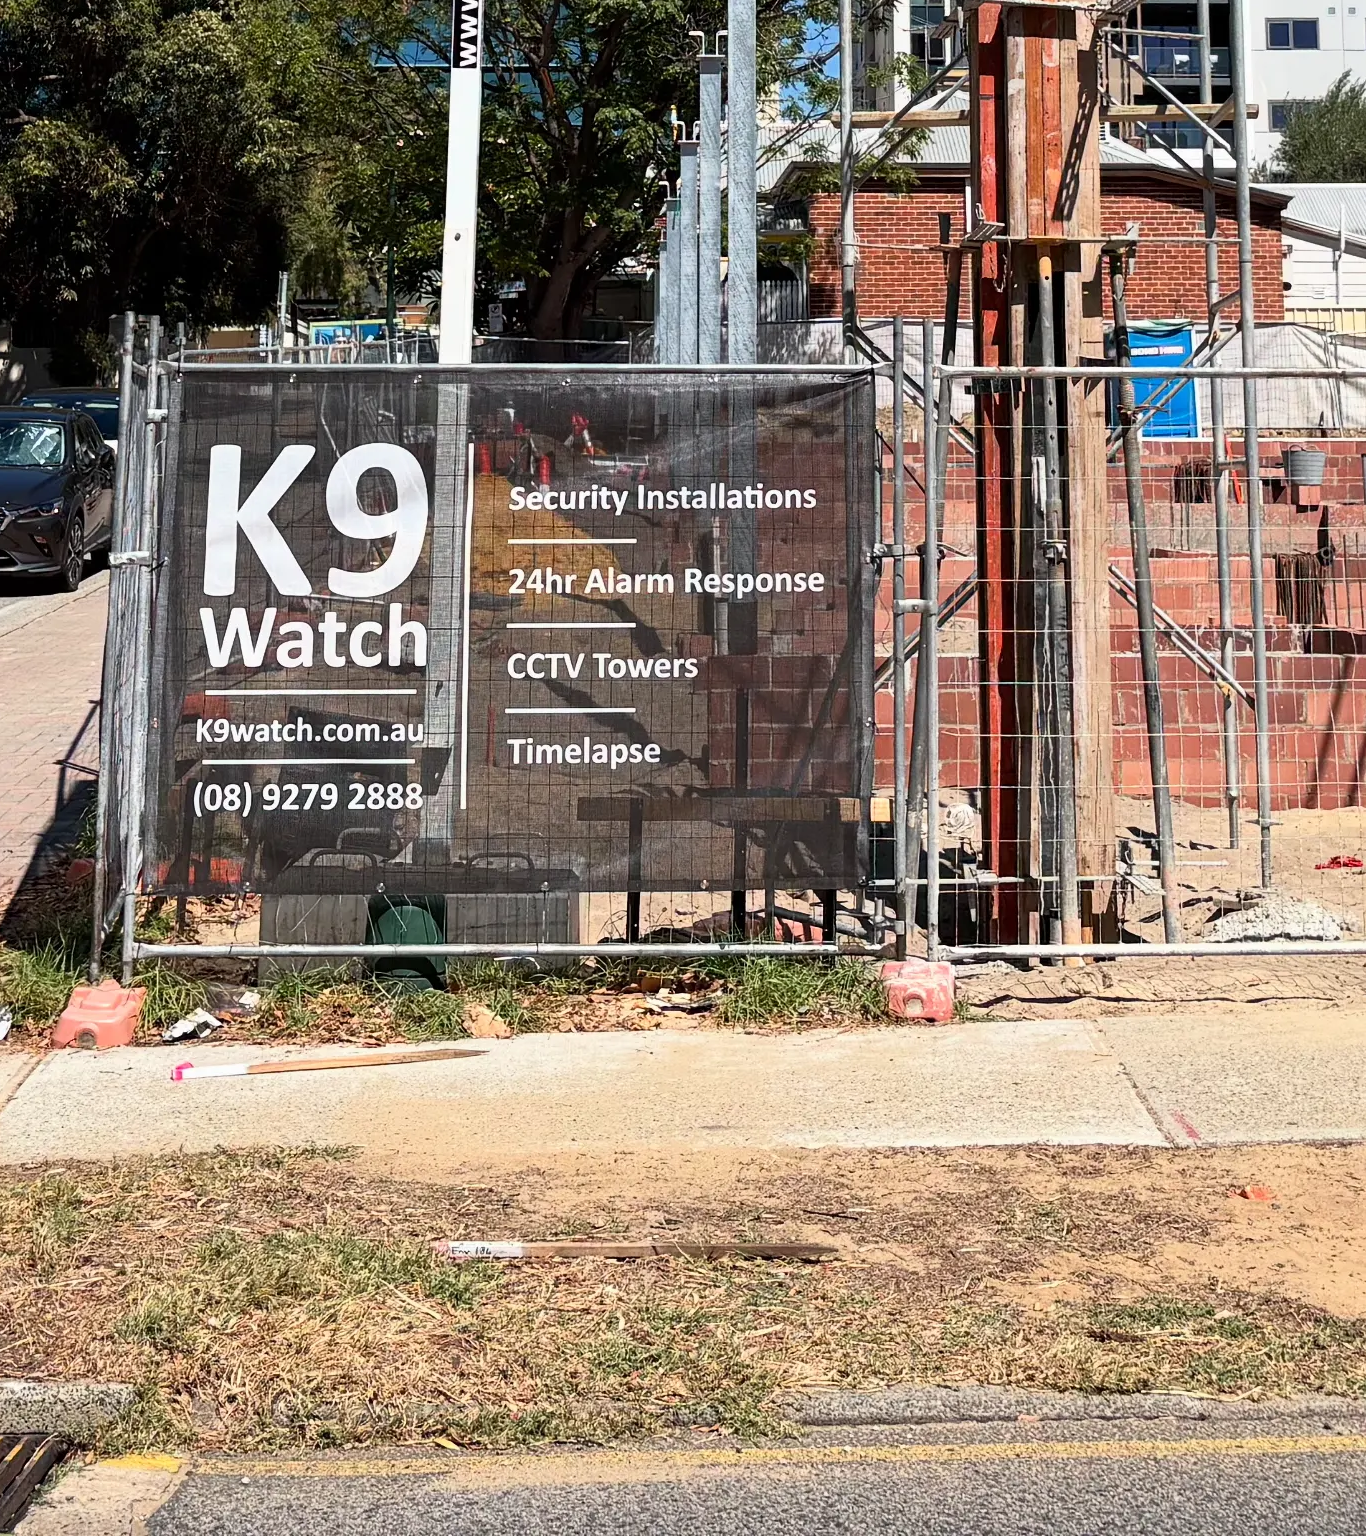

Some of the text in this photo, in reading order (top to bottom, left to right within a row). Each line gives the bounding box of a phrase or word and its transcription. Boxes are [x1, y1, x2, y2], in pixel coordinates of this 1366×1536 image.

[508, 483, 817, 516] Security Installations
[205, 442, 429, 597] K9
[508, 567, 825, 599] 24hr Alarm Response
[200, 602, 428, 668] Watch
[507, 652, 699, 679] CCTV Towers
[195, 717, 425, 745] K9watch.com.au
[507, 737, 661, 768] Timelapse
[193, 782, 424, 817] (08) 9279 2888
